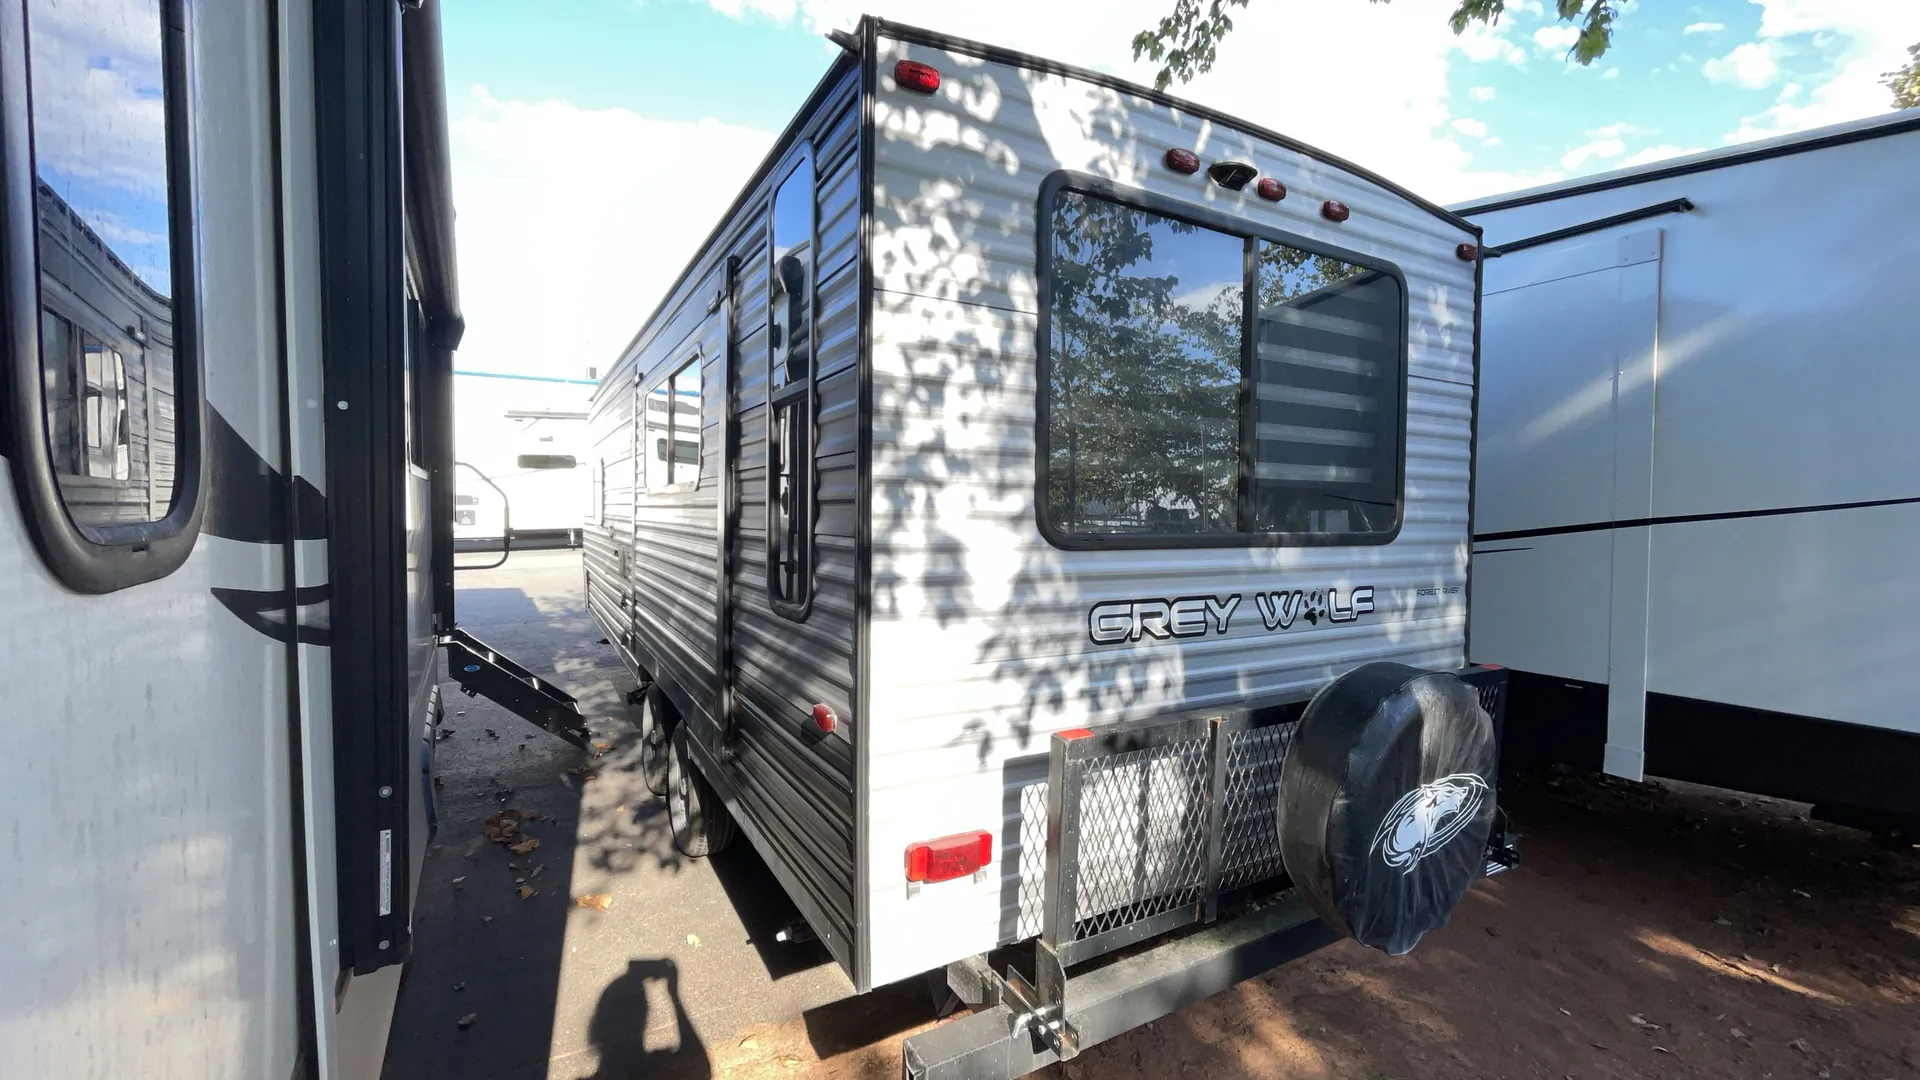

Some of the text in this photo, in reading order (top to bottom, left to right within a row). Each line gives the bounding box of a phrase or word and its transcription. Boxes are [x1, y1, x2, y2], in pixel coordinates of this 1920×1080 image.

[1416, 586, 1459, 597] FOREST RIVER
[1089, 593, 1241, 645] GREY
